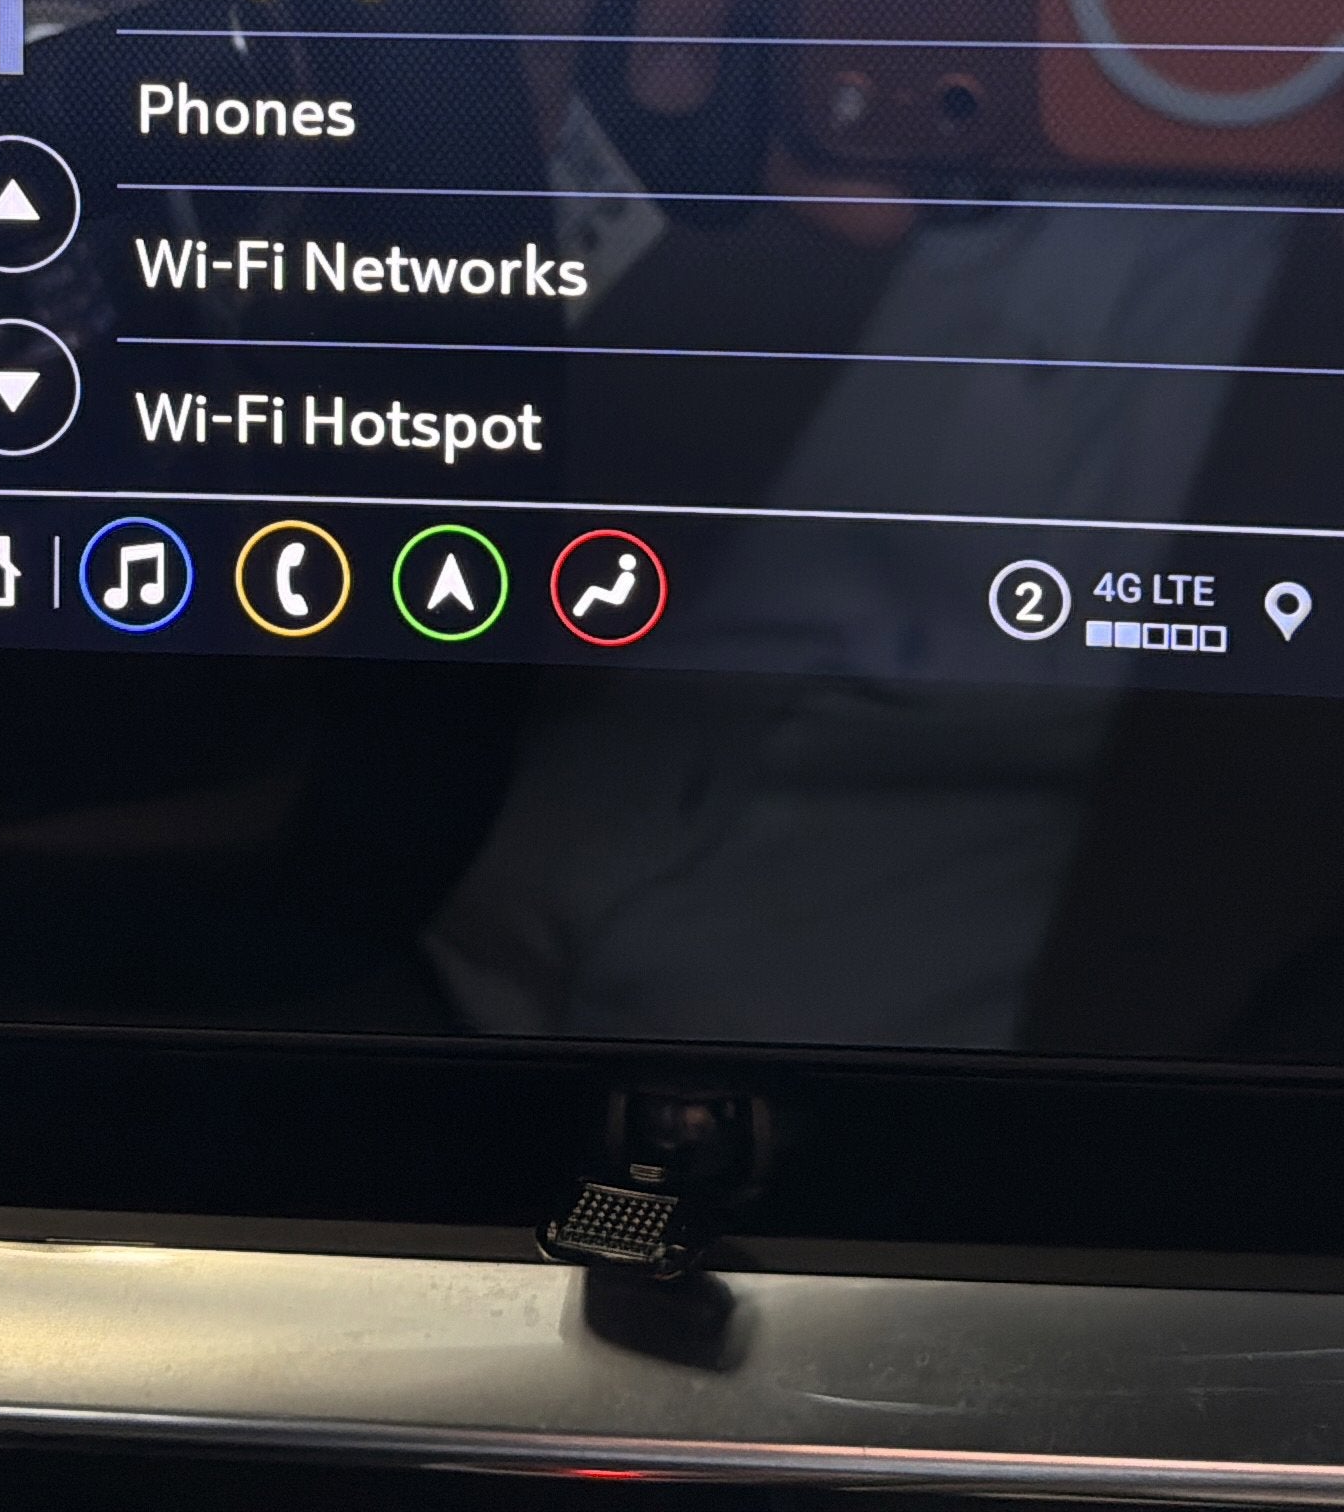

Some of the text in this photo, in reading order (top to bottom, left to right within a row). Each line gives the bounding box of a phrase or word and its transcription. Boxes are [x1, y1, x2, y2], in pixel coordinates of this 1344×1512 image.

[140, 82, 357, 139] Phones
[135, 238, 589, 299] Wi-Fi Networks
[135, 392, 544, 465] Wi-Fi Hotspot
[1012, 581, 1045, 624] 2
[1093, 572, 1217, 609] 4G LTE
